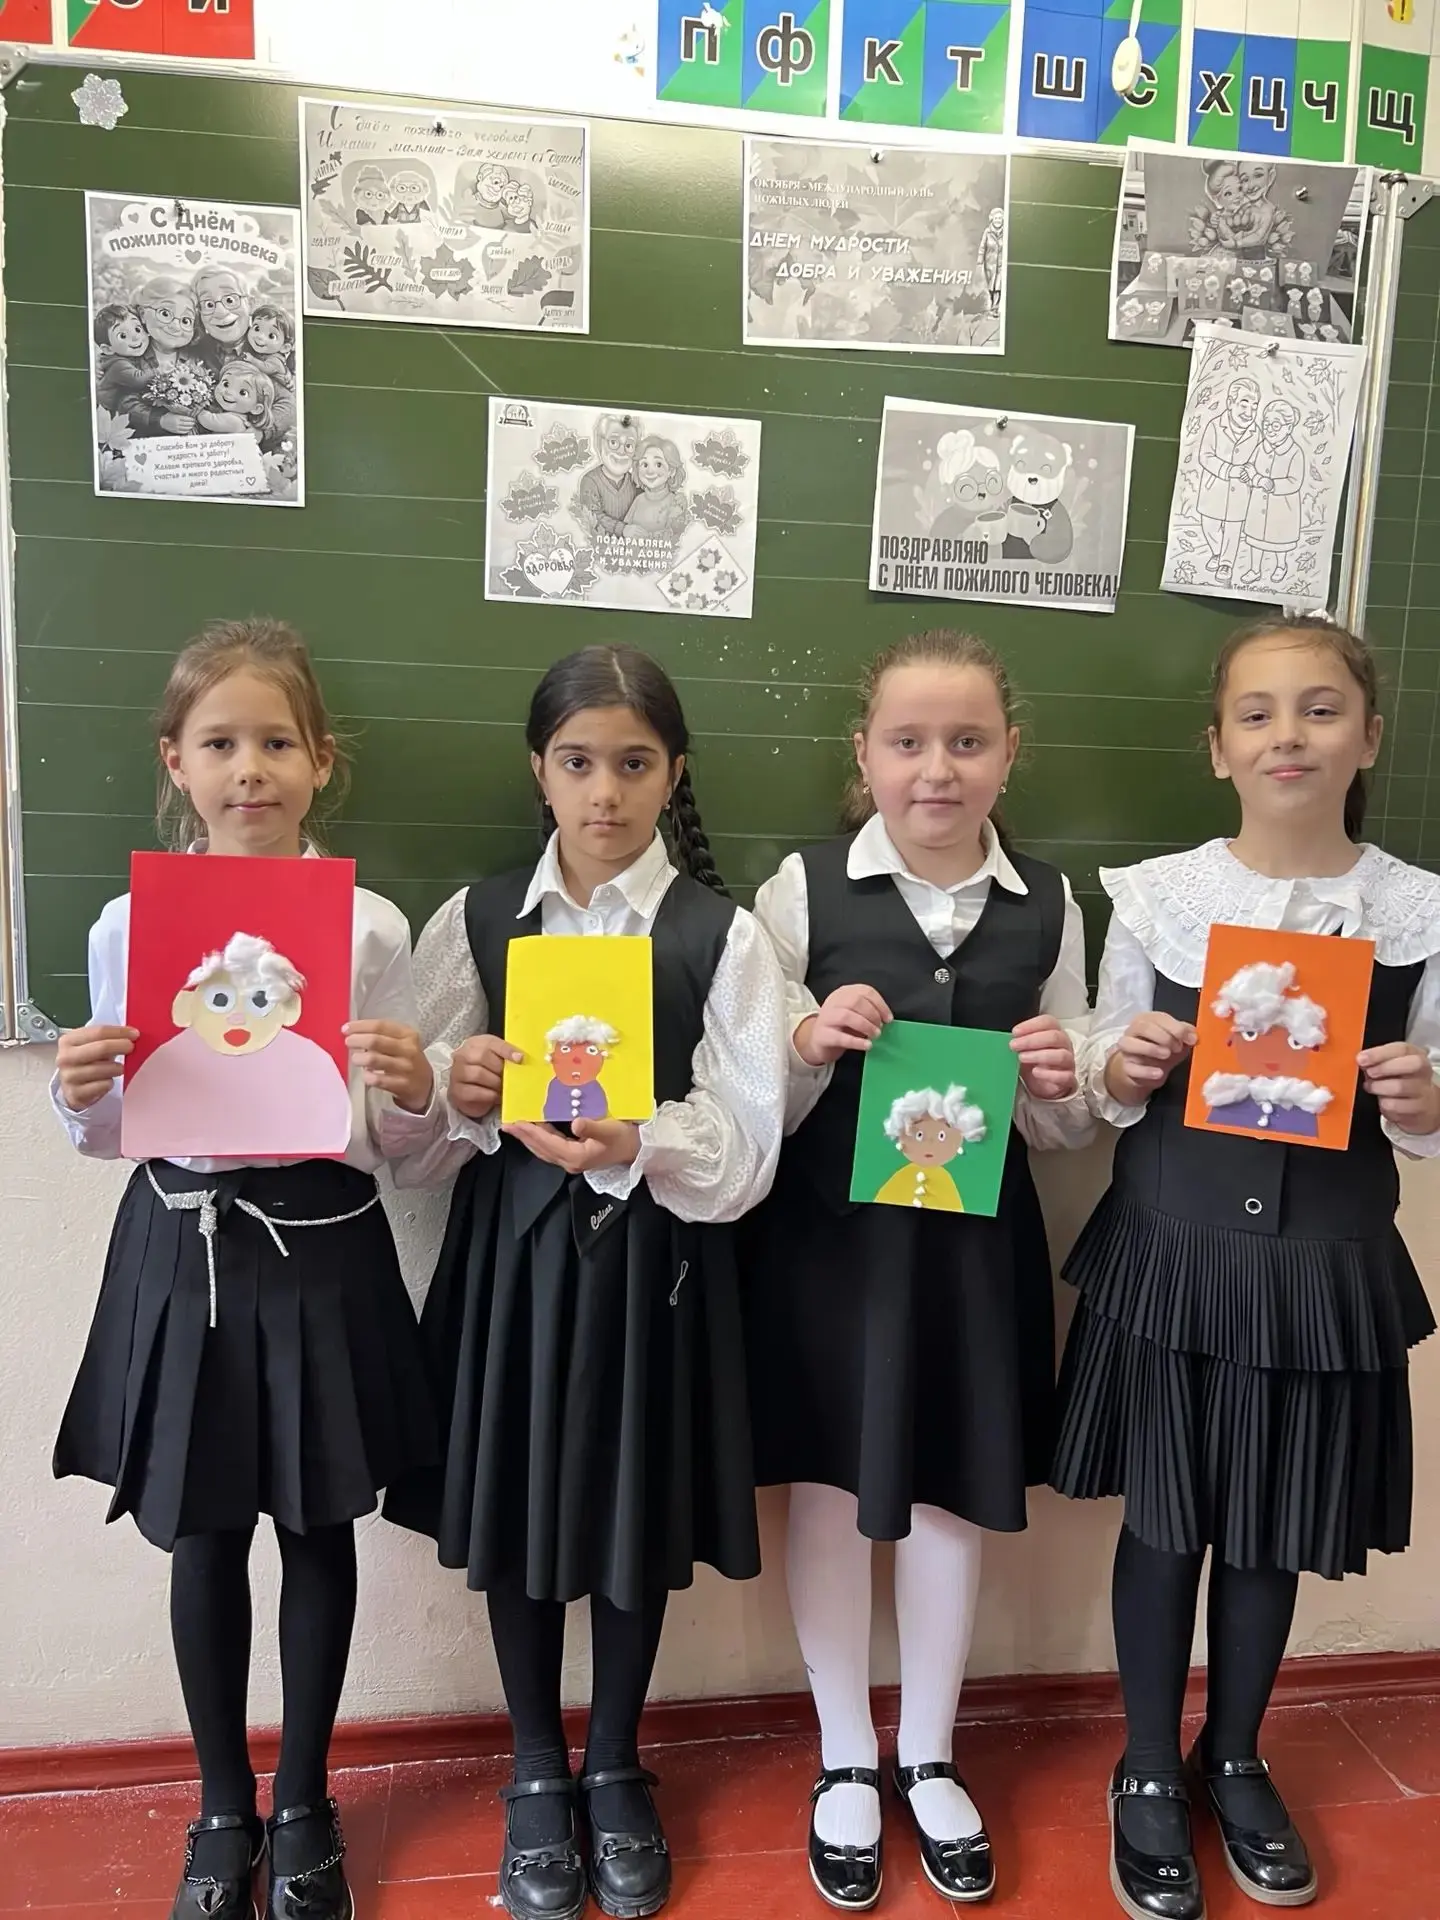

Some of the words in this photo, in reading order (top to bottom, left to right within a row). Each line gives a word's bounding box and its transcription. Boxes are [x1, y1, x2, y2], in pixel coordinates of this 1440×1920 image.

[754, 178, 800, 191] ОКТЯБРЯ
[808, 182, 903, 197] МЕЖДУНАРОДНЫЙ
[754, 194, 810, 207] ПОЖИЛЫХ
[150, 207, 168, 228] С
[175, 208, 236, 234] Днём
[109, 232, 195, 252] пожилого
[200, 233, 279, 265] человека
[750, 231, 801, 249] ДНЕМ
[776, 262, 837, 279] ДОБРА
[848, 265, 861, 281] И
[871, 268, 973, 285] УВАЖЕНИЯ!
[596, 534, 672, 550] ПОЗДРАВЛЯЕМ
[879, 535, 989, 565] ПОЗДРАВЛЯЮ
[637, 549, 673, 560] ДОБРА
[525, 560, 575, 577] ЗДОРОВЬЯ
[611, 558, 668, 570] УВАЖЕНИЯ
[878, 563, 888, 587] С
[893, 565, 938, 591] ДНЕМ
[944, 567, 1029, 595] ПОЖИЛОГО
[1035, 571, 1118, 598] ЧЕЛОВЕКА!
